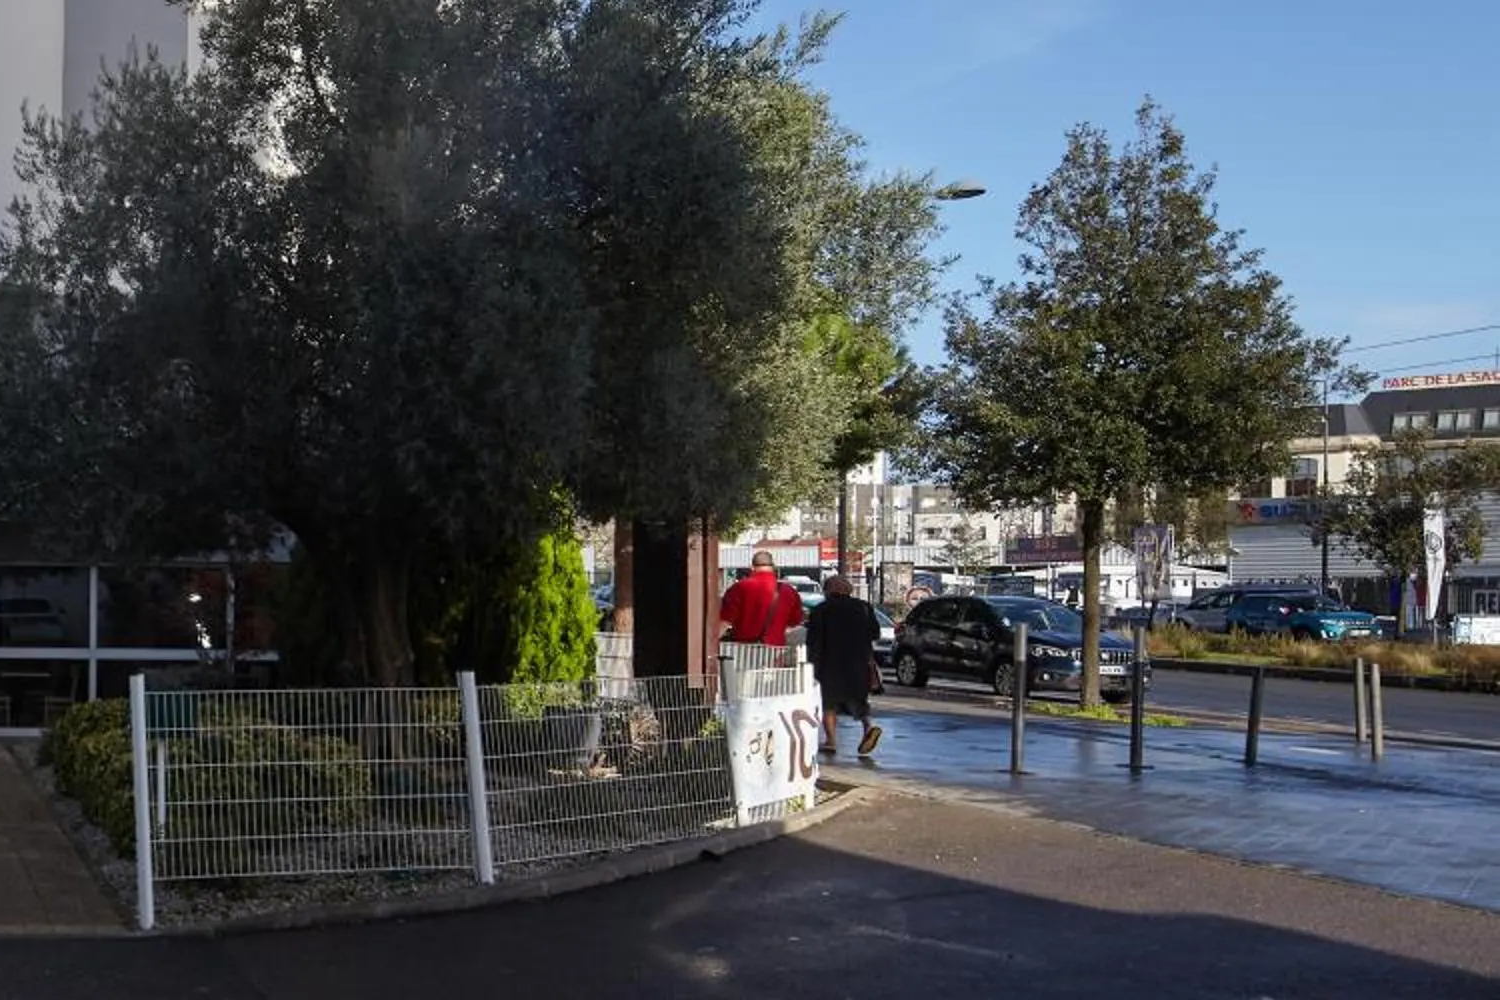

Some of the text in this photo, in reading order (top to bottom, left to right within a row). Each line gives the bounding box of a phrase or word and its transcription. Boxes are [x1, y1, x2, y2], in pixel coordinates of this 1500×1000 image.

[1383, 376, 1418, 388] PARC
[1425, 374, 1445, 385] DE
[1447, 373, 1466, 384] LA
